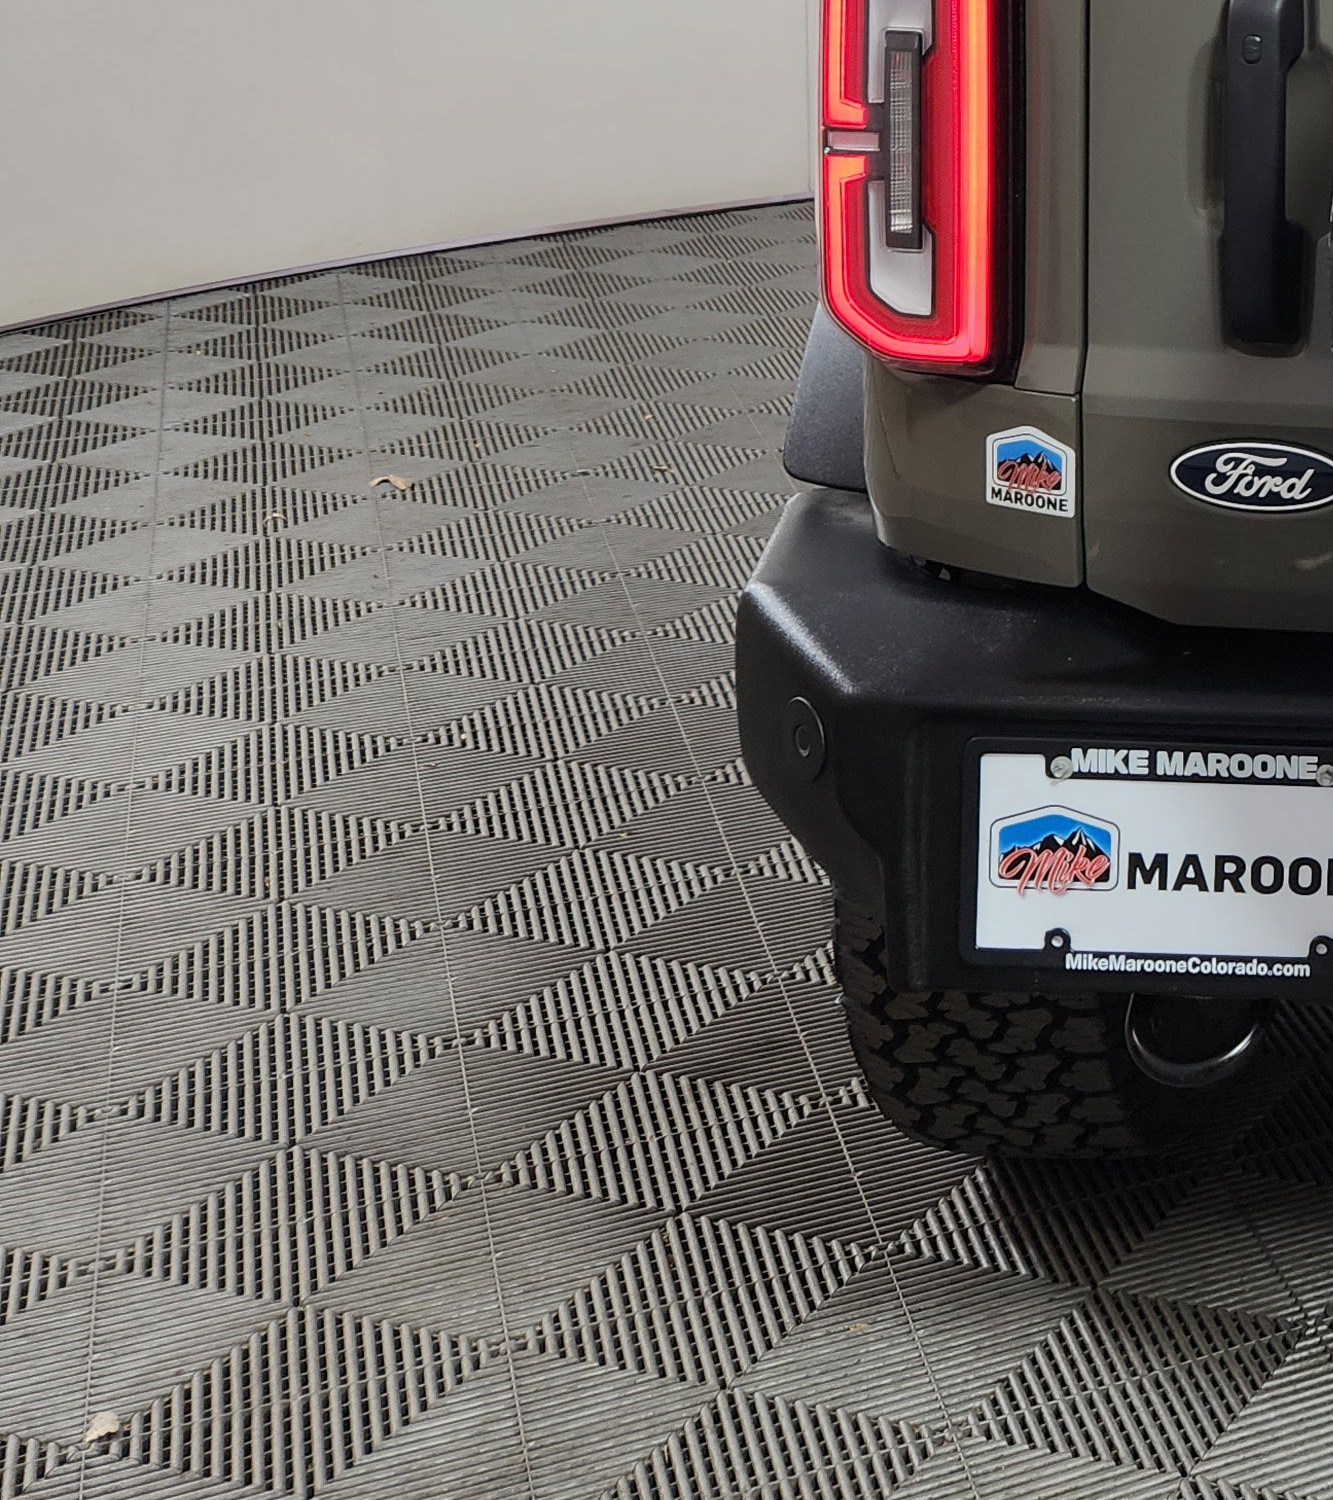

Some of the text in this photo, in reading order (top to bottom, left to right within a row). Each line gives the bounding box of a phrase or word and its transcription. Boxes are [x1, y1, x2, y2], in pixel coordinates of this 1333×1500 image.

[996, 460, 1062, 494] Mike
[1204, 452, 1314, 500] Ford
[990, 486, 1069, 513] MAROONE
[1070, 747, 1319, 781] MIKE MAROONE
[999, 844, 1111, 898] Mike
[1065, 953, 1311, 978] MikeMarooneColorado.com
